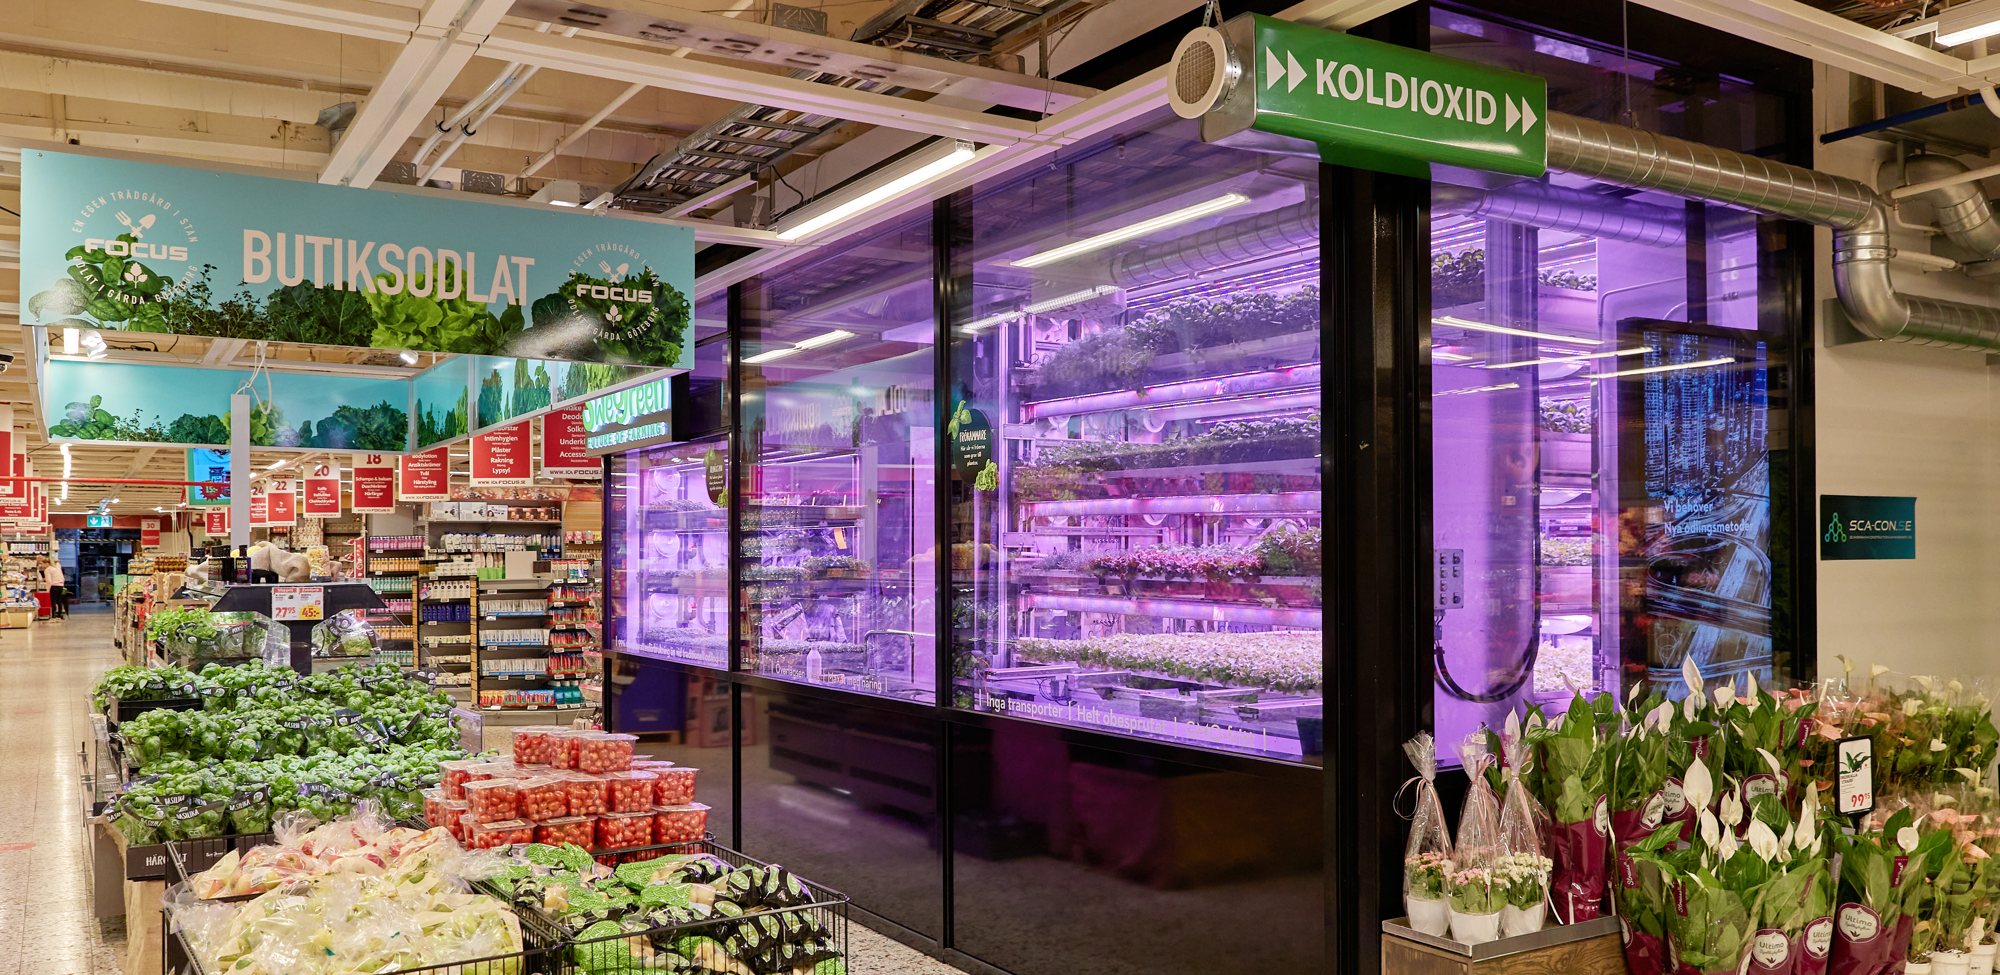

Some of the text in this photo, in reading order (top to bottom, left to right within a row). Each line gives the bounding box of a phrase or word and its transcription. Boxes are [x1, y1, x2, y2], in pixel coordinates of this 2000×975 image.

[1316, 57, 1498, 126] KOLDIOXID
[72, 219, 86, 233] EN
[81, 196, 107, 218] EGEN
[110, 189, 171, 210] TRÄDGÅRD
[180, 218, 199, 243] STAN
[84, 238, 189, 261] FOCUS
[73, 255, 99, 285] ODLAT
[243, 228, 536, 307] BUTIKSODLAT
[576, 284, 653, 304] FOCUS
[627, 306, 660, 339] GÖTEBORG
[314, 465, 330, 477] 20
[252, 487, 264, 496] 24
[275, 480, 288, 491] 22
[1664, 498, 1713, 513] Vi behöver
[1664, 522, 1684, 537] Nya
[1849, 520, 1912, 531] SCA-CON.SE
[986, 692, 1006, 712] Inga
[1008, 697, 1063, 718] transporter
[1077, 704, 1101, 724] Helt
[1845, 914, 1873, 926] Ultimo
[1759, 941, 1785, 950] Ultimo
